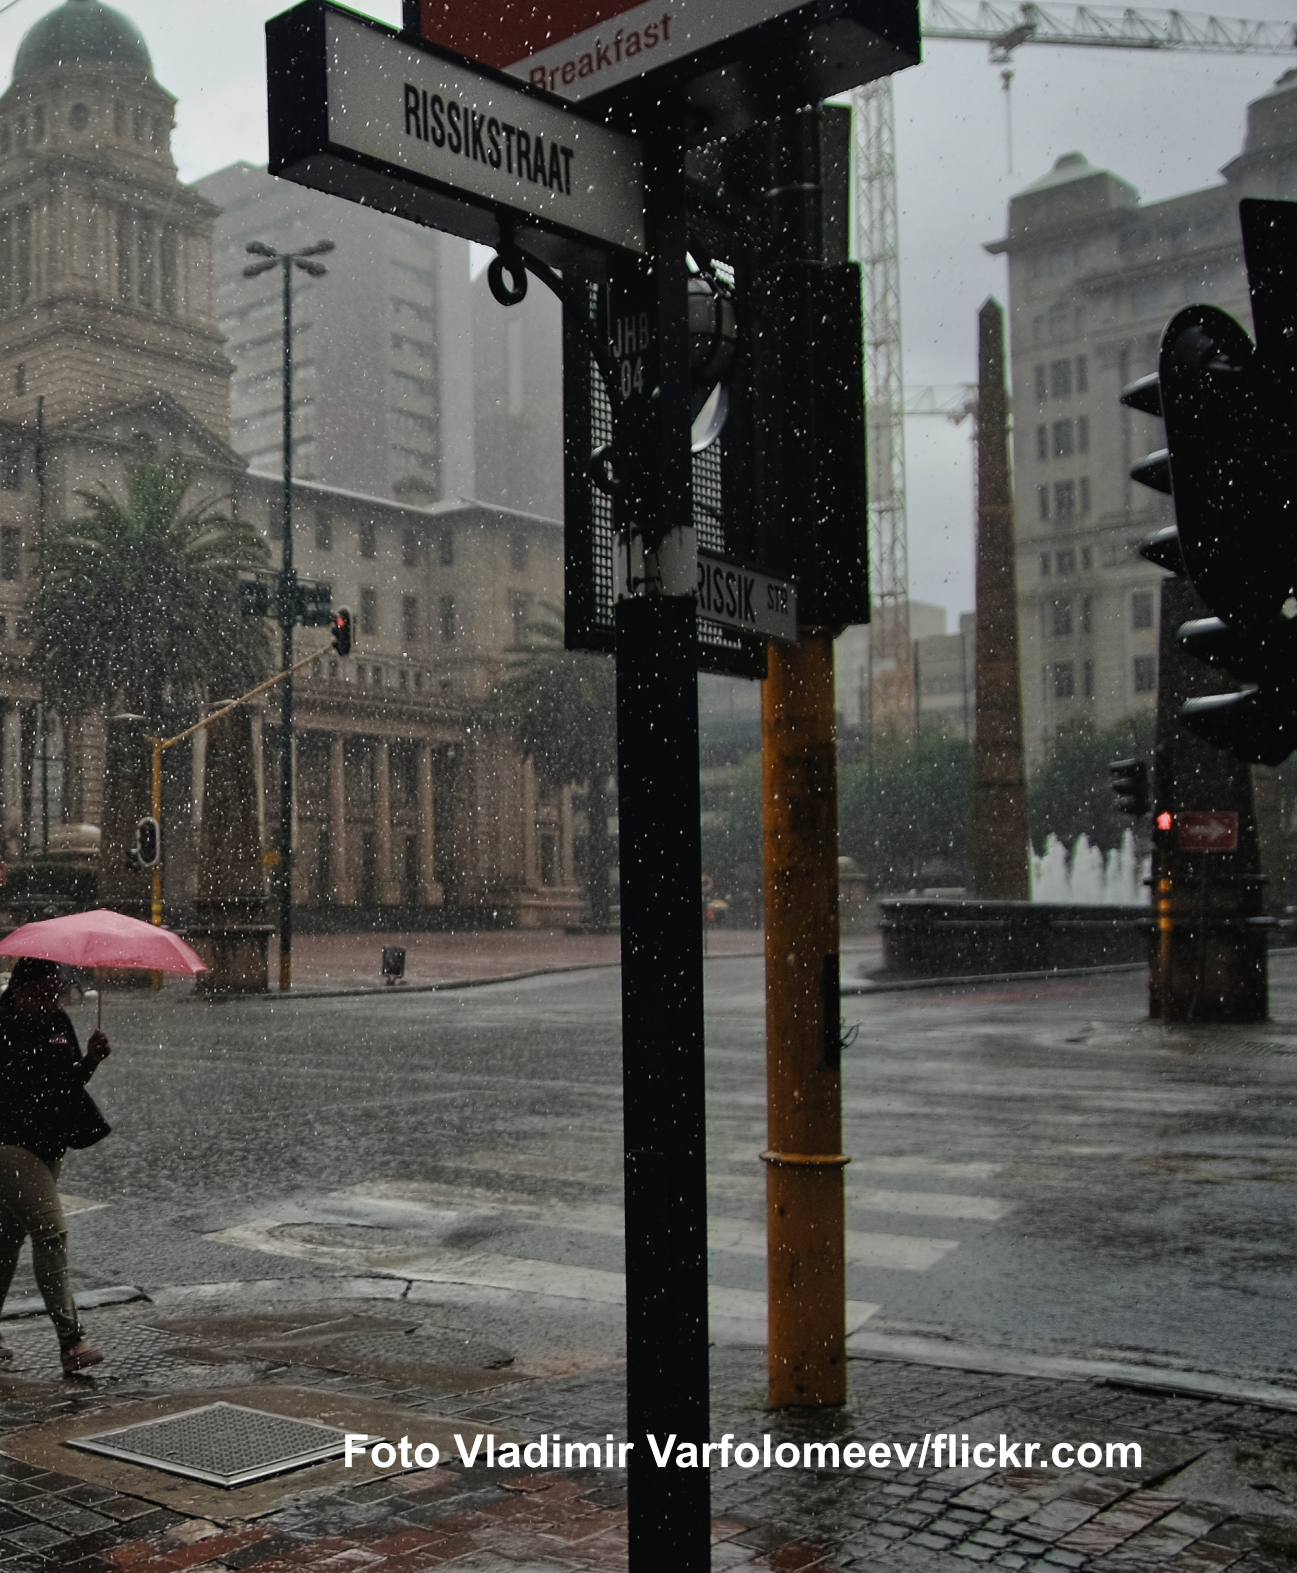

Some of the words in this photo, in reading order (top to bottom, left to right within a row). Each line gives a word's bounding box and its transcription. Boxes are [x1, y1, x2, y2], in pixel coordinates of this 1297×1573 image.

[529, 12, 673, 91] Breakfast
[404, 83, 575, 196] RISSIKSTRAAT
[613, 312, 649, 358] JHB
[621, 356, 643, 399] 04
[697, 562, 756, 622] RISSIK
[767, 583, 788, 615] STR
